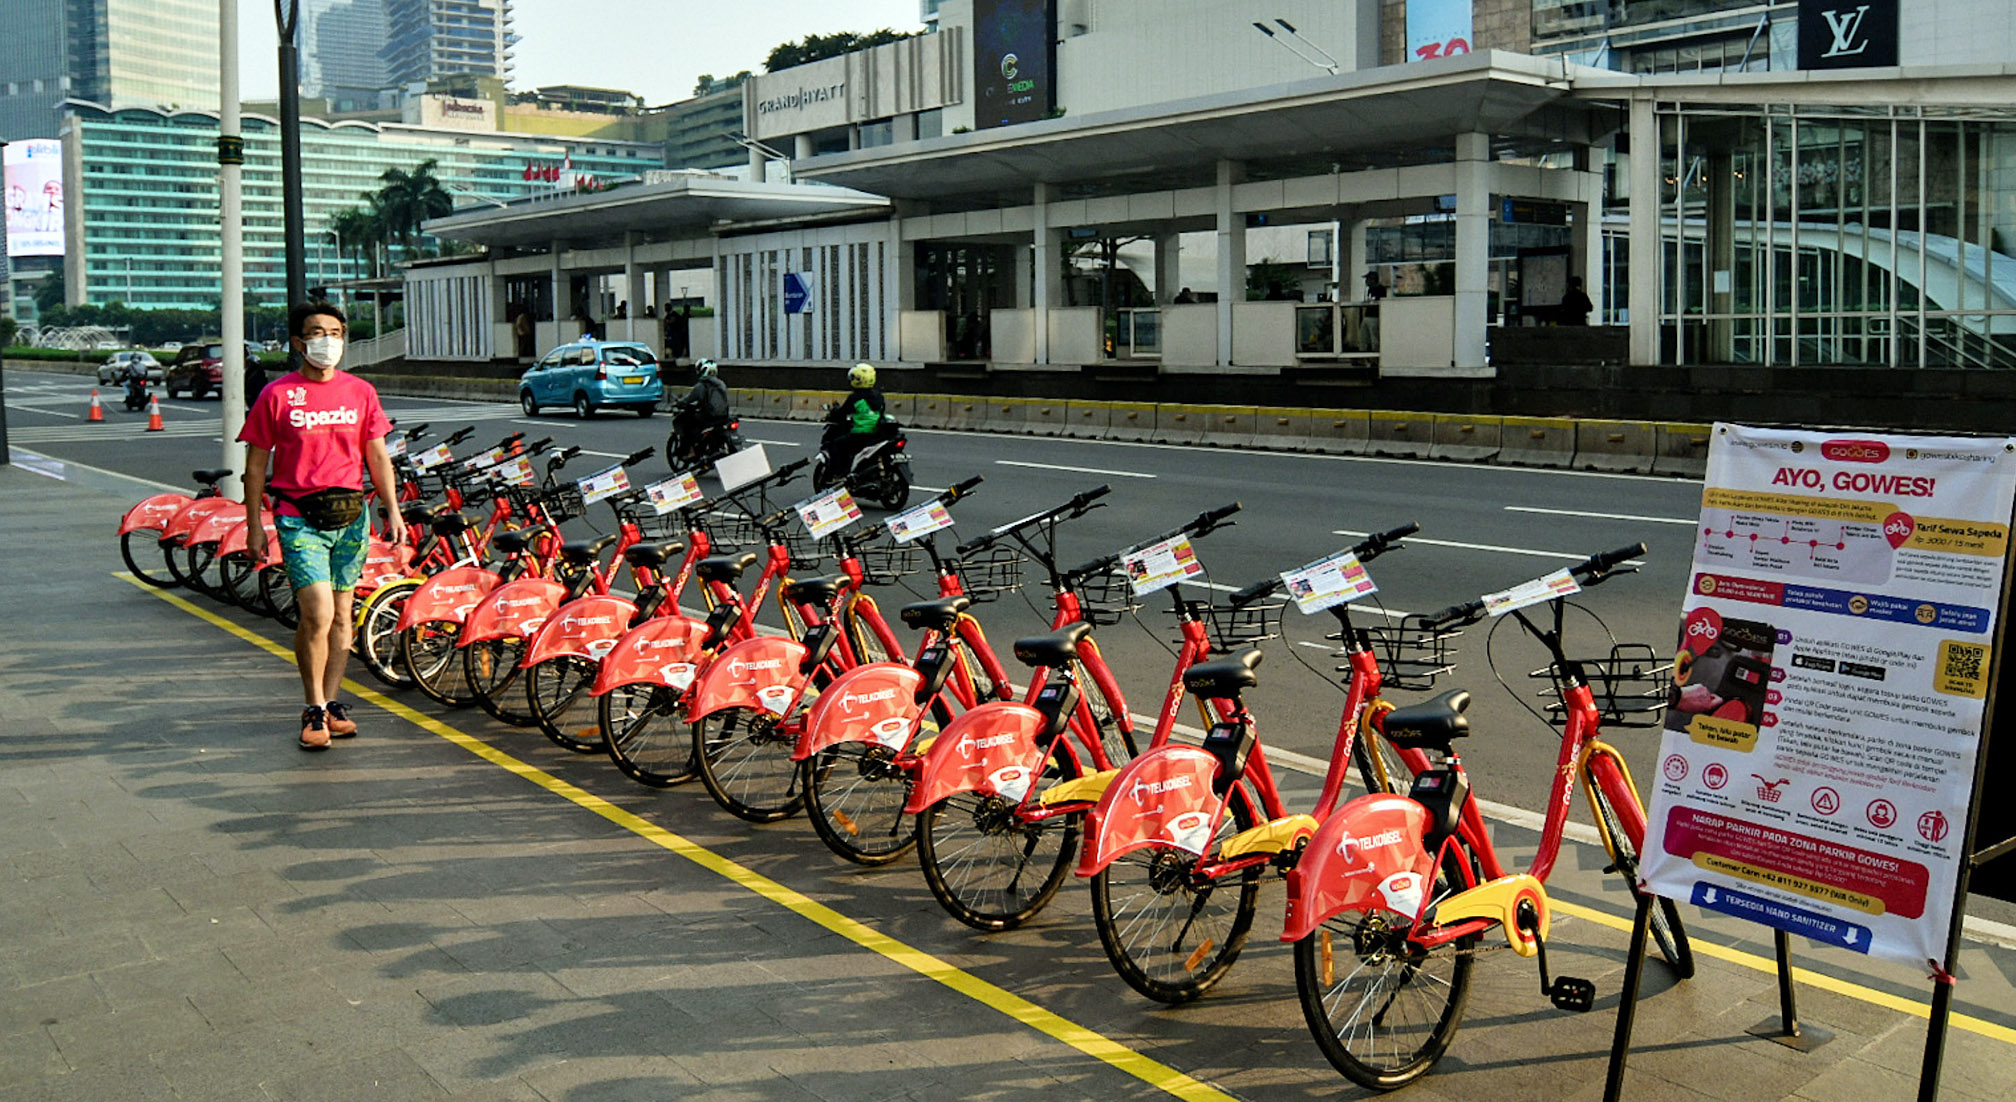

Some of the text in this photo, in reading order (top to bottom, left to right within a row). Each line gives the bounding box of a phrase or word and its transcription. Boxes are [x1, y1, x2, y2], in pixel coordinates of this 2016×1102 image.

[759, 83, 845, 114] GRAND HYATT
[290, 406, 358, 430] Spazio
[1771, 467, 1937, 498] AYO, GOWES!
[1917, 523, 2003, 539] Tarif Sewa Sepeda
[744, 658, 782, 671] TELKOMSEL
[857, 687, 897, 705] TELKOMSEL
[974, 732, 1016, 750] TELKOMSEL
[1149, 775, 1193, 795] TELKOMSEL
[1357, 830, 1403, 851] TELKOMSEL
[1692, 814, 1725, 828] HARAP
[1725, 821, 1762, 838] PARKIR
[1762, 830, 1789, 844] PADA
[1789, 837, 1818, 852] ZONA
[1818, 843, 1857, 861] PARKIR
[1857, 853, 1900, 873] GOWES!
[1706, 857, 1741, 872] Customer
[1761, 873, 1777, 882] +62
[1777, 876, 1792, 887] 811
[1724, 894, 1764, 913] TERSEDIA
[1765, 905, 1791, 920] HAND
[1790, 913, 1838, 934] SANITIZER
